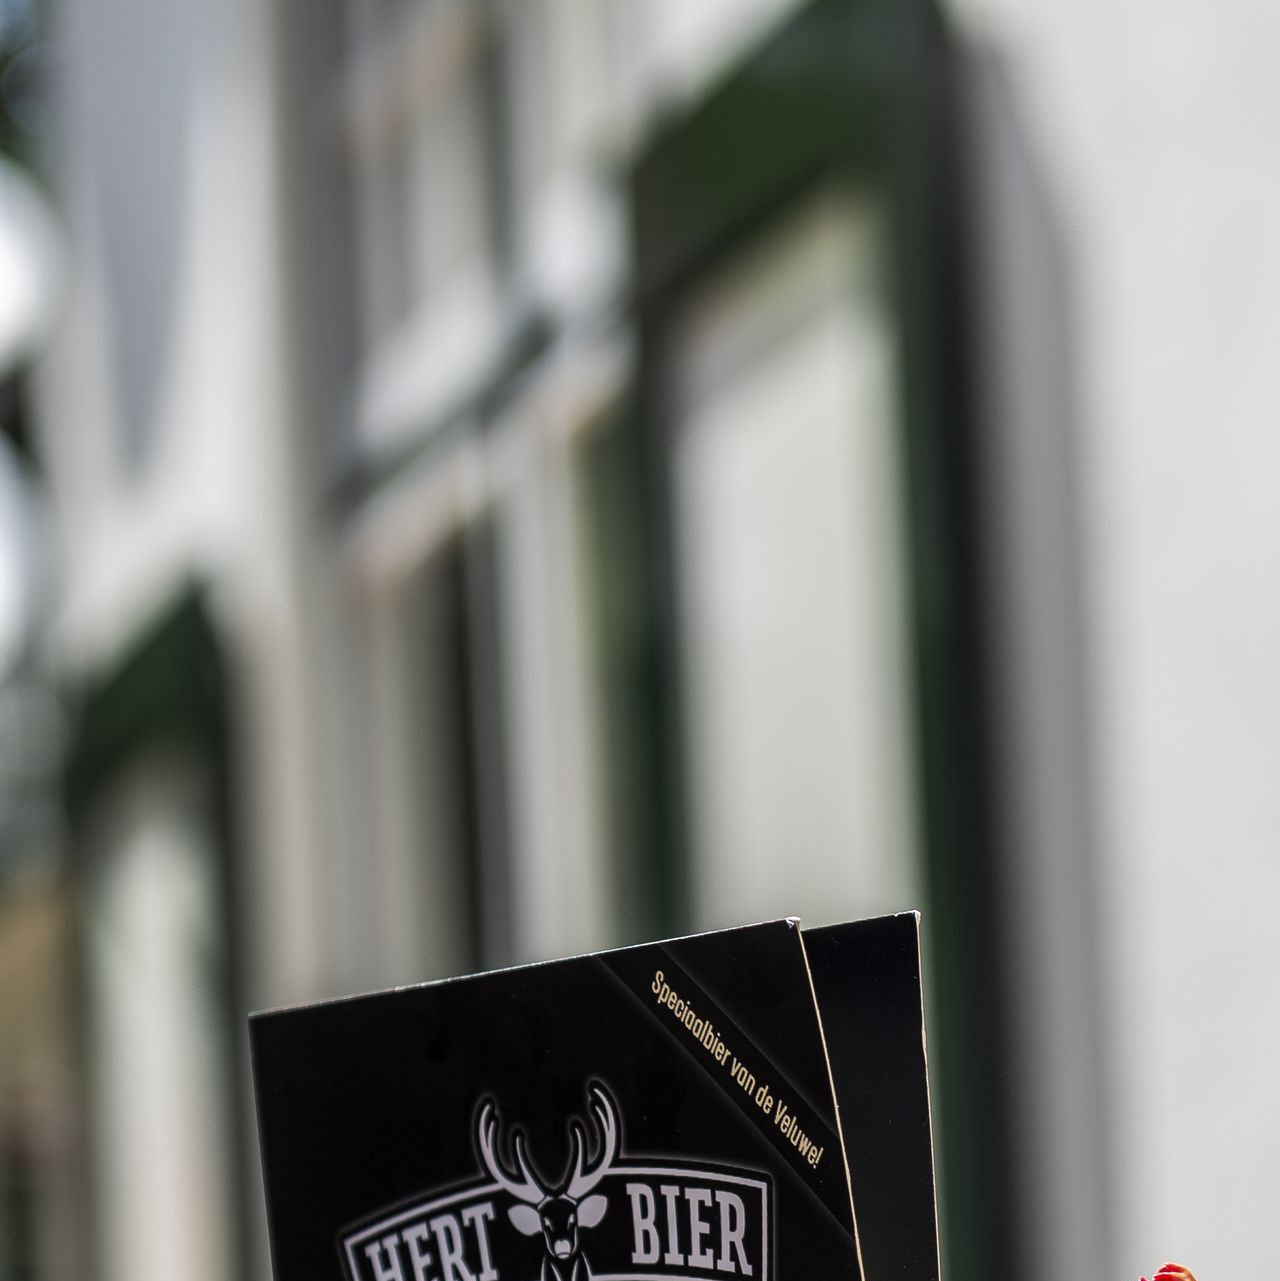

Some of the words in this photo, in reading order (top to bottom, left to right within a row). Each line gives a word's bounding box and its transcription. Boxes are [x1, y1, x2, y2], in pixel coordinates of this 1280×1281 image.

[651, 970, 731, 1066] Speciaalbier
[730, 1057, 757, 1096] van
[755, 1085, 774, 1115] de
[774, 1099, 824, 1169] Veluwe!
[625, 1182, 753, 1277] BIER
